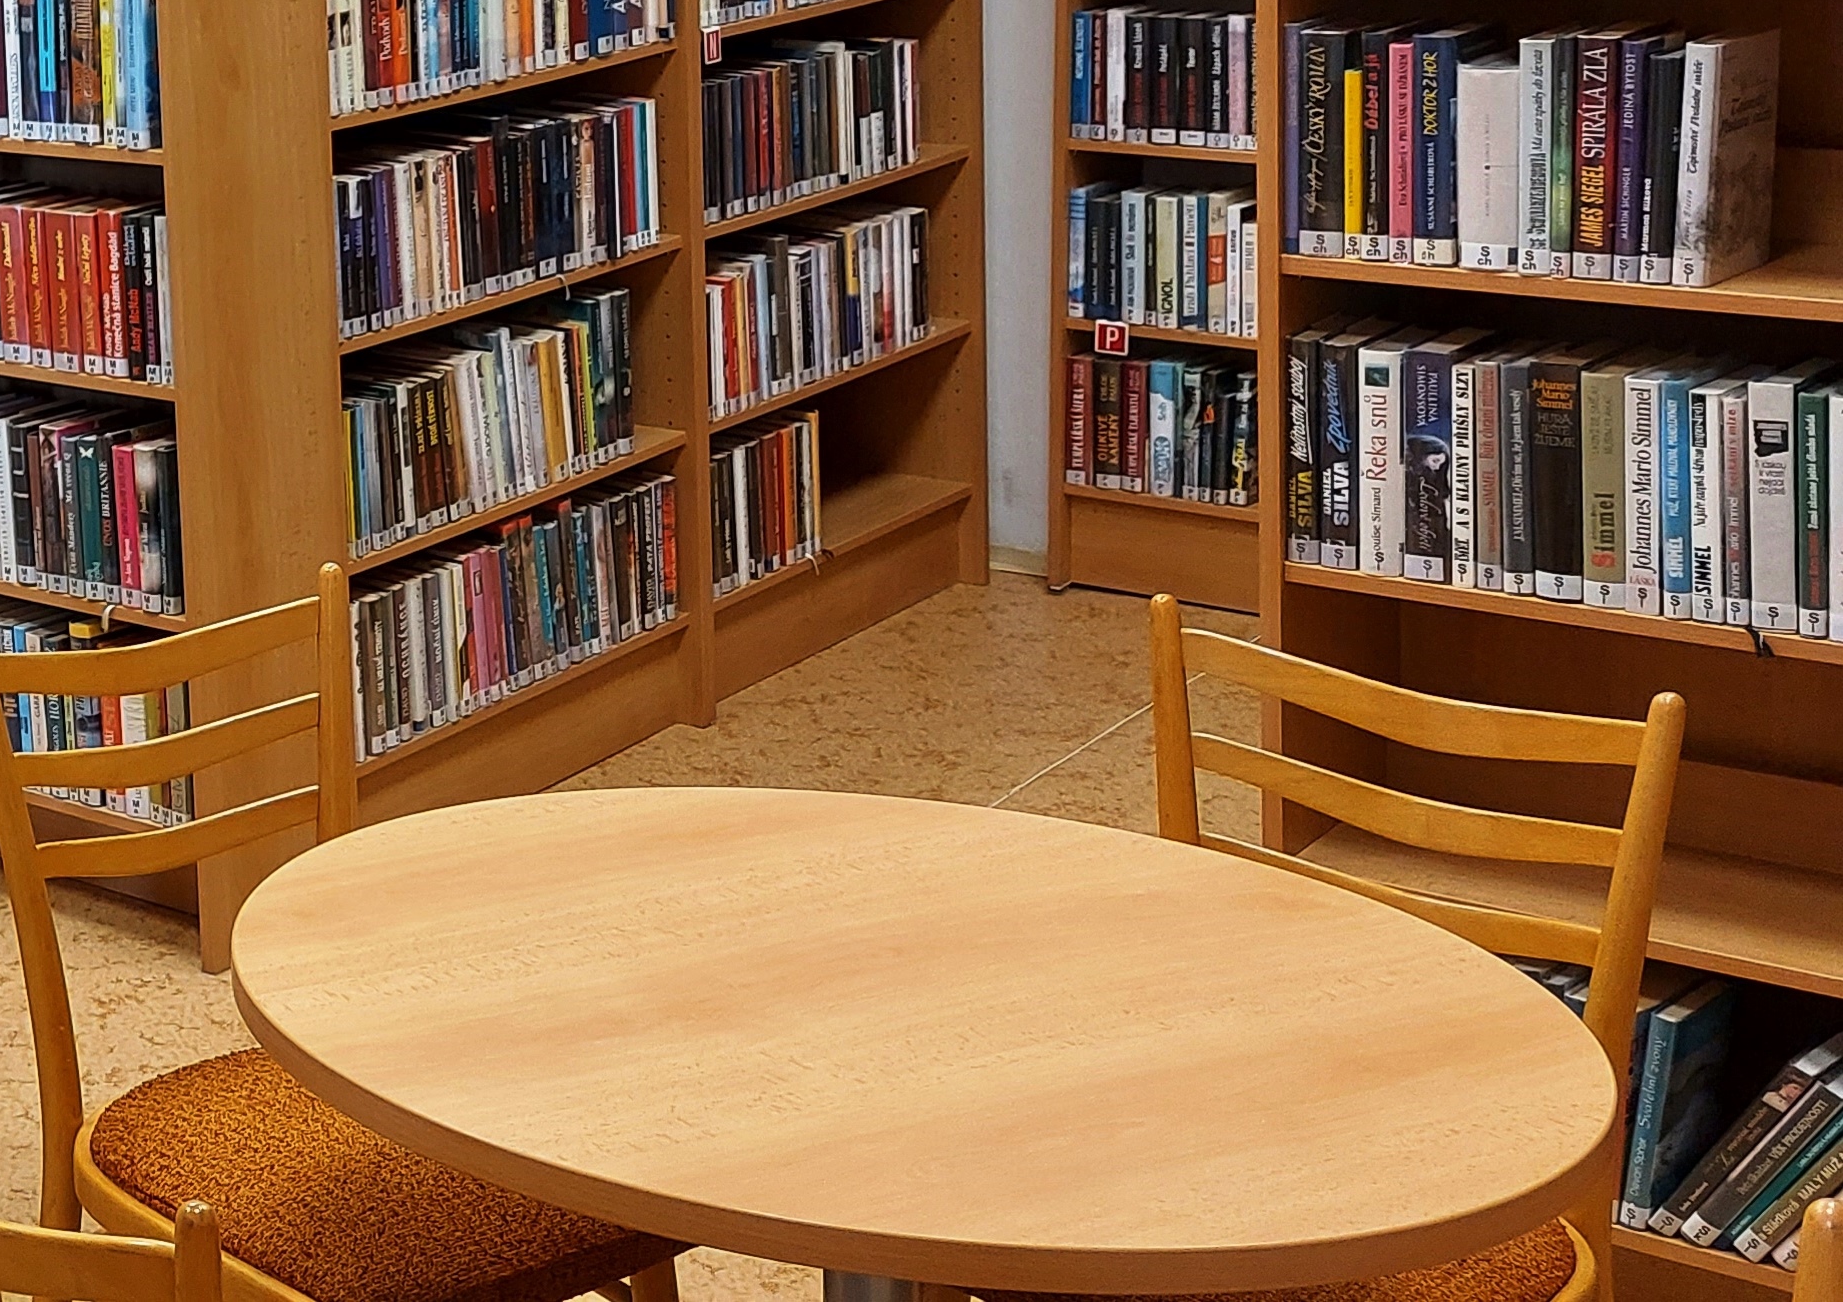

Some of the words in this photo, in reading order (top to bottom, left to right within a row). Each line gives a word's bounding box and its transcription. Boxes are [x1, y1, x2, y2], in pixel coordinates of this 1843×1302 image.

[708, 32, 718, 59] N
[1364, 53, 1381, 69] já
[1423, 53, 1438, 74] HOR
[1583, 48, 1608, 82] ZLA
[1369, 72, 1377, 81] a
[1624, 53, 1636, 89] BYTOST
[1302, 105, 1326, 153] ČESKÝ
[1423, 89, 1438, 135] DOKTOR
[1578, 88, 1607, 158] SPIRÁLA
[1623, 92, 1634, 129] JEDINÁ
[1580, 165, 1604, 204] SIEGEL
[1316, 235, 1325, 245] S
[1580, 207, 1604, 246] JAMES
[108, 232, 119, 271] Bagdád
[111, 273, 120, 311] stanice
[112, 313, 124, 357] Konečná
[130, 326, 141, 352] Andy
[1106, 326, 1119, 349] P
[1455, 369, 1469, 399] SLZY
[1363, 394, 1387, 428] snů
[1629, 388, 1652, 447] Simmel
[1361, 436, 1387, 481] Řeka
[1456, 454, 1469, 501] KLAUNY
[1632, 449, 1652, 496] Mario
[1296, 470, 1313, 528] SILVA
[1323, 468, 1332, 515] DANIEL
[1333, 462, 1350, 526] SILVA
[1369, 487, 1381, 521] Simard
[1456, 508, 1469, 516] S
[1456, 521, 1469, 529] A
[1590, 493, 1616, 568] Simmel
[1630, 500, 1656, 573] Johannes
[1667, 537, 1684, 578] SIMMEL
[1694, 545, 1711, 595] SIMMEL
